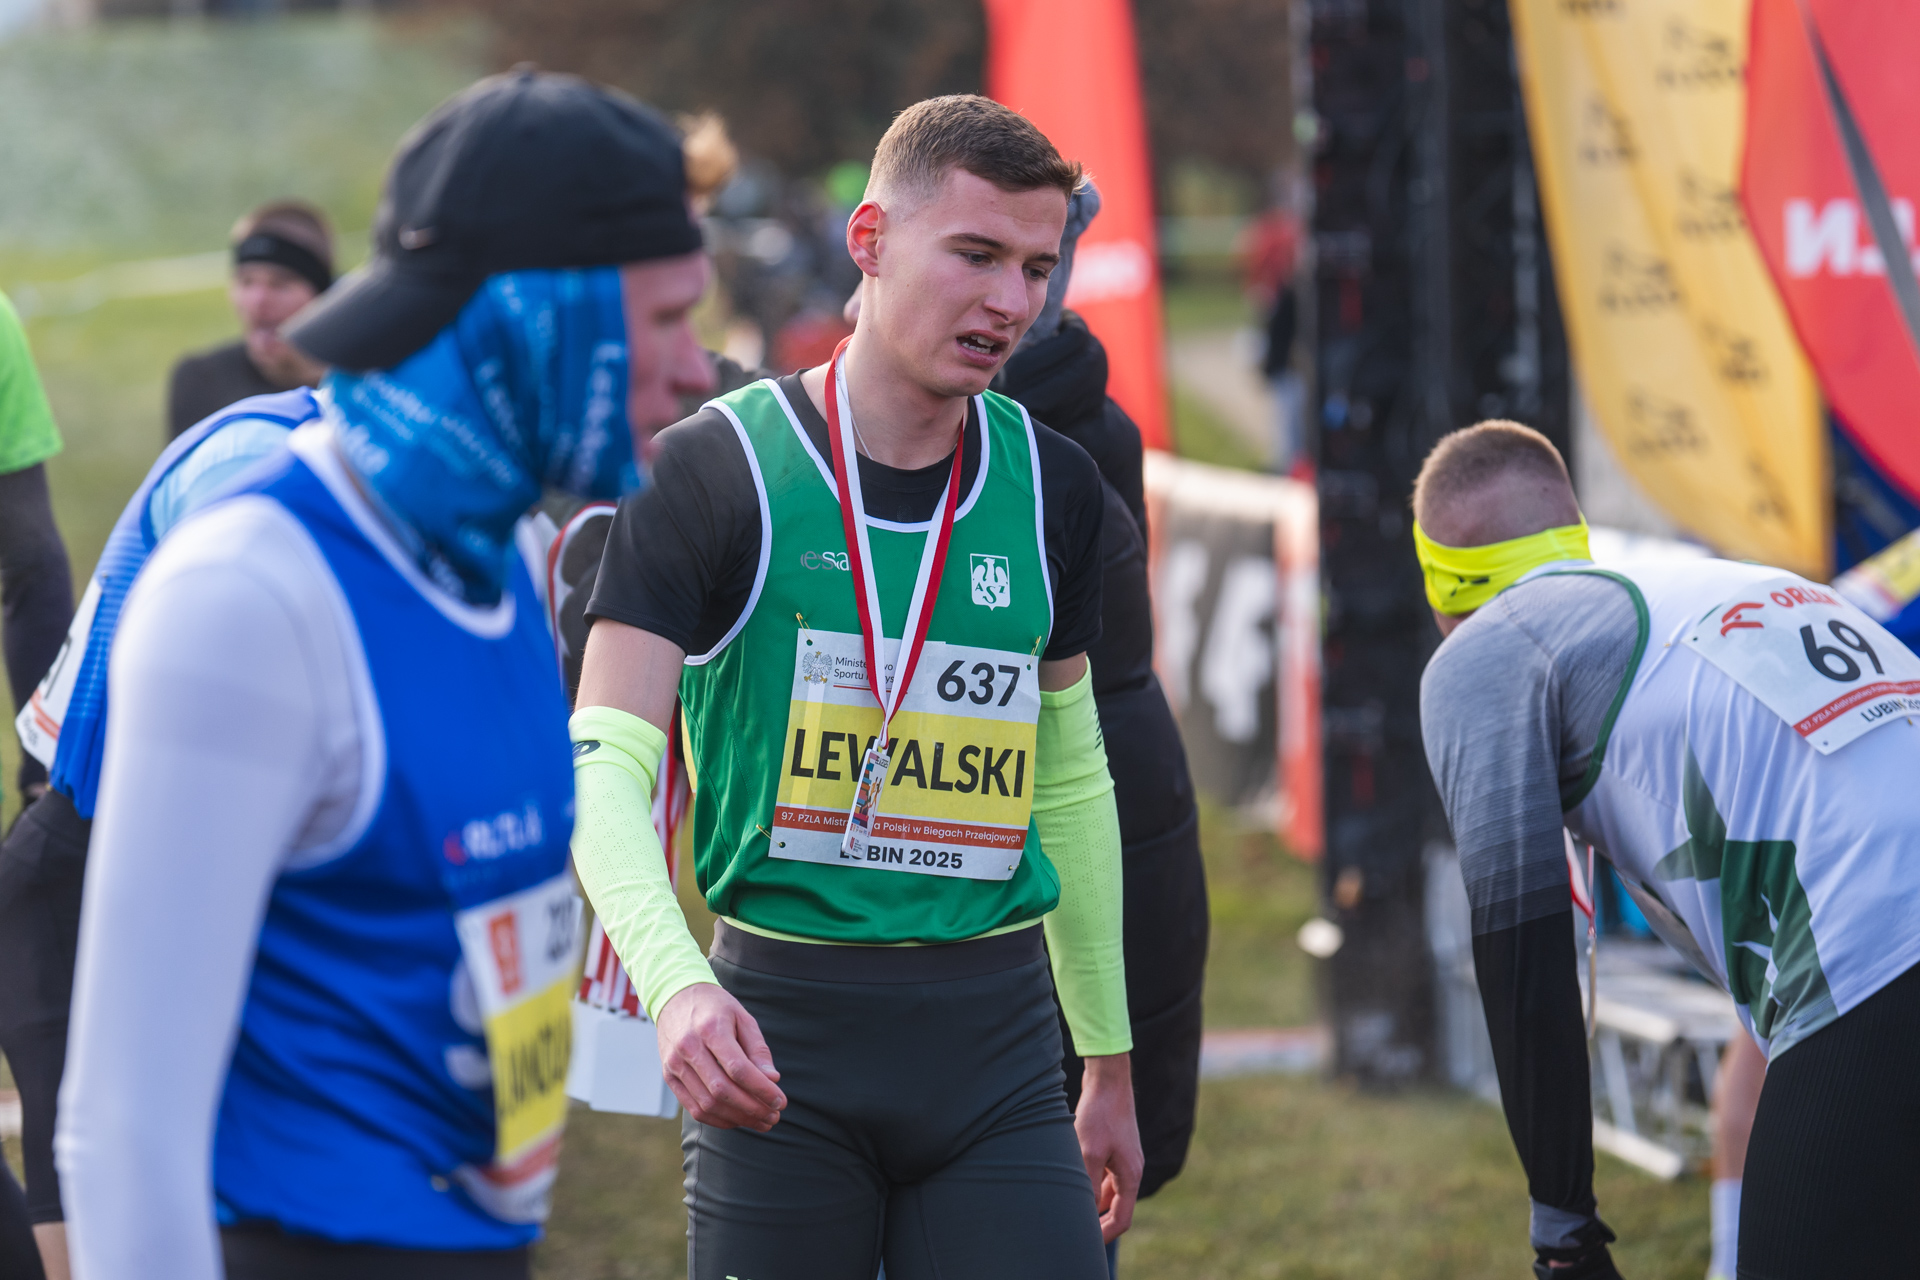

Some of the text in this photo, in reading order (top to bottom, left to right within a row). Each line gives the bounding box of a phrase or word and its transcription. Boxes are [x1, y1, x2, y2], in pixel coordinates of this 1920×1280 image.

[1800, 619, 1885, 682] 69
[833, 668, 864, 680] Sportu
[937, 660, 1021, 707] 637
[790, 728, 1027, 798] LEWALSKI
[781, 811, 795, 822] 97.
[798, 813, 821, 824] PZLA
[883, 822, 911, 834] Polski
[913, 826, 921, 834] w
[923, 826, 963, 839] Biegach
[965, 830, 1021, 844] Przełajowych
[839, 842, 904, 864] LBIN
[909, 848, 963, 870] 2025
